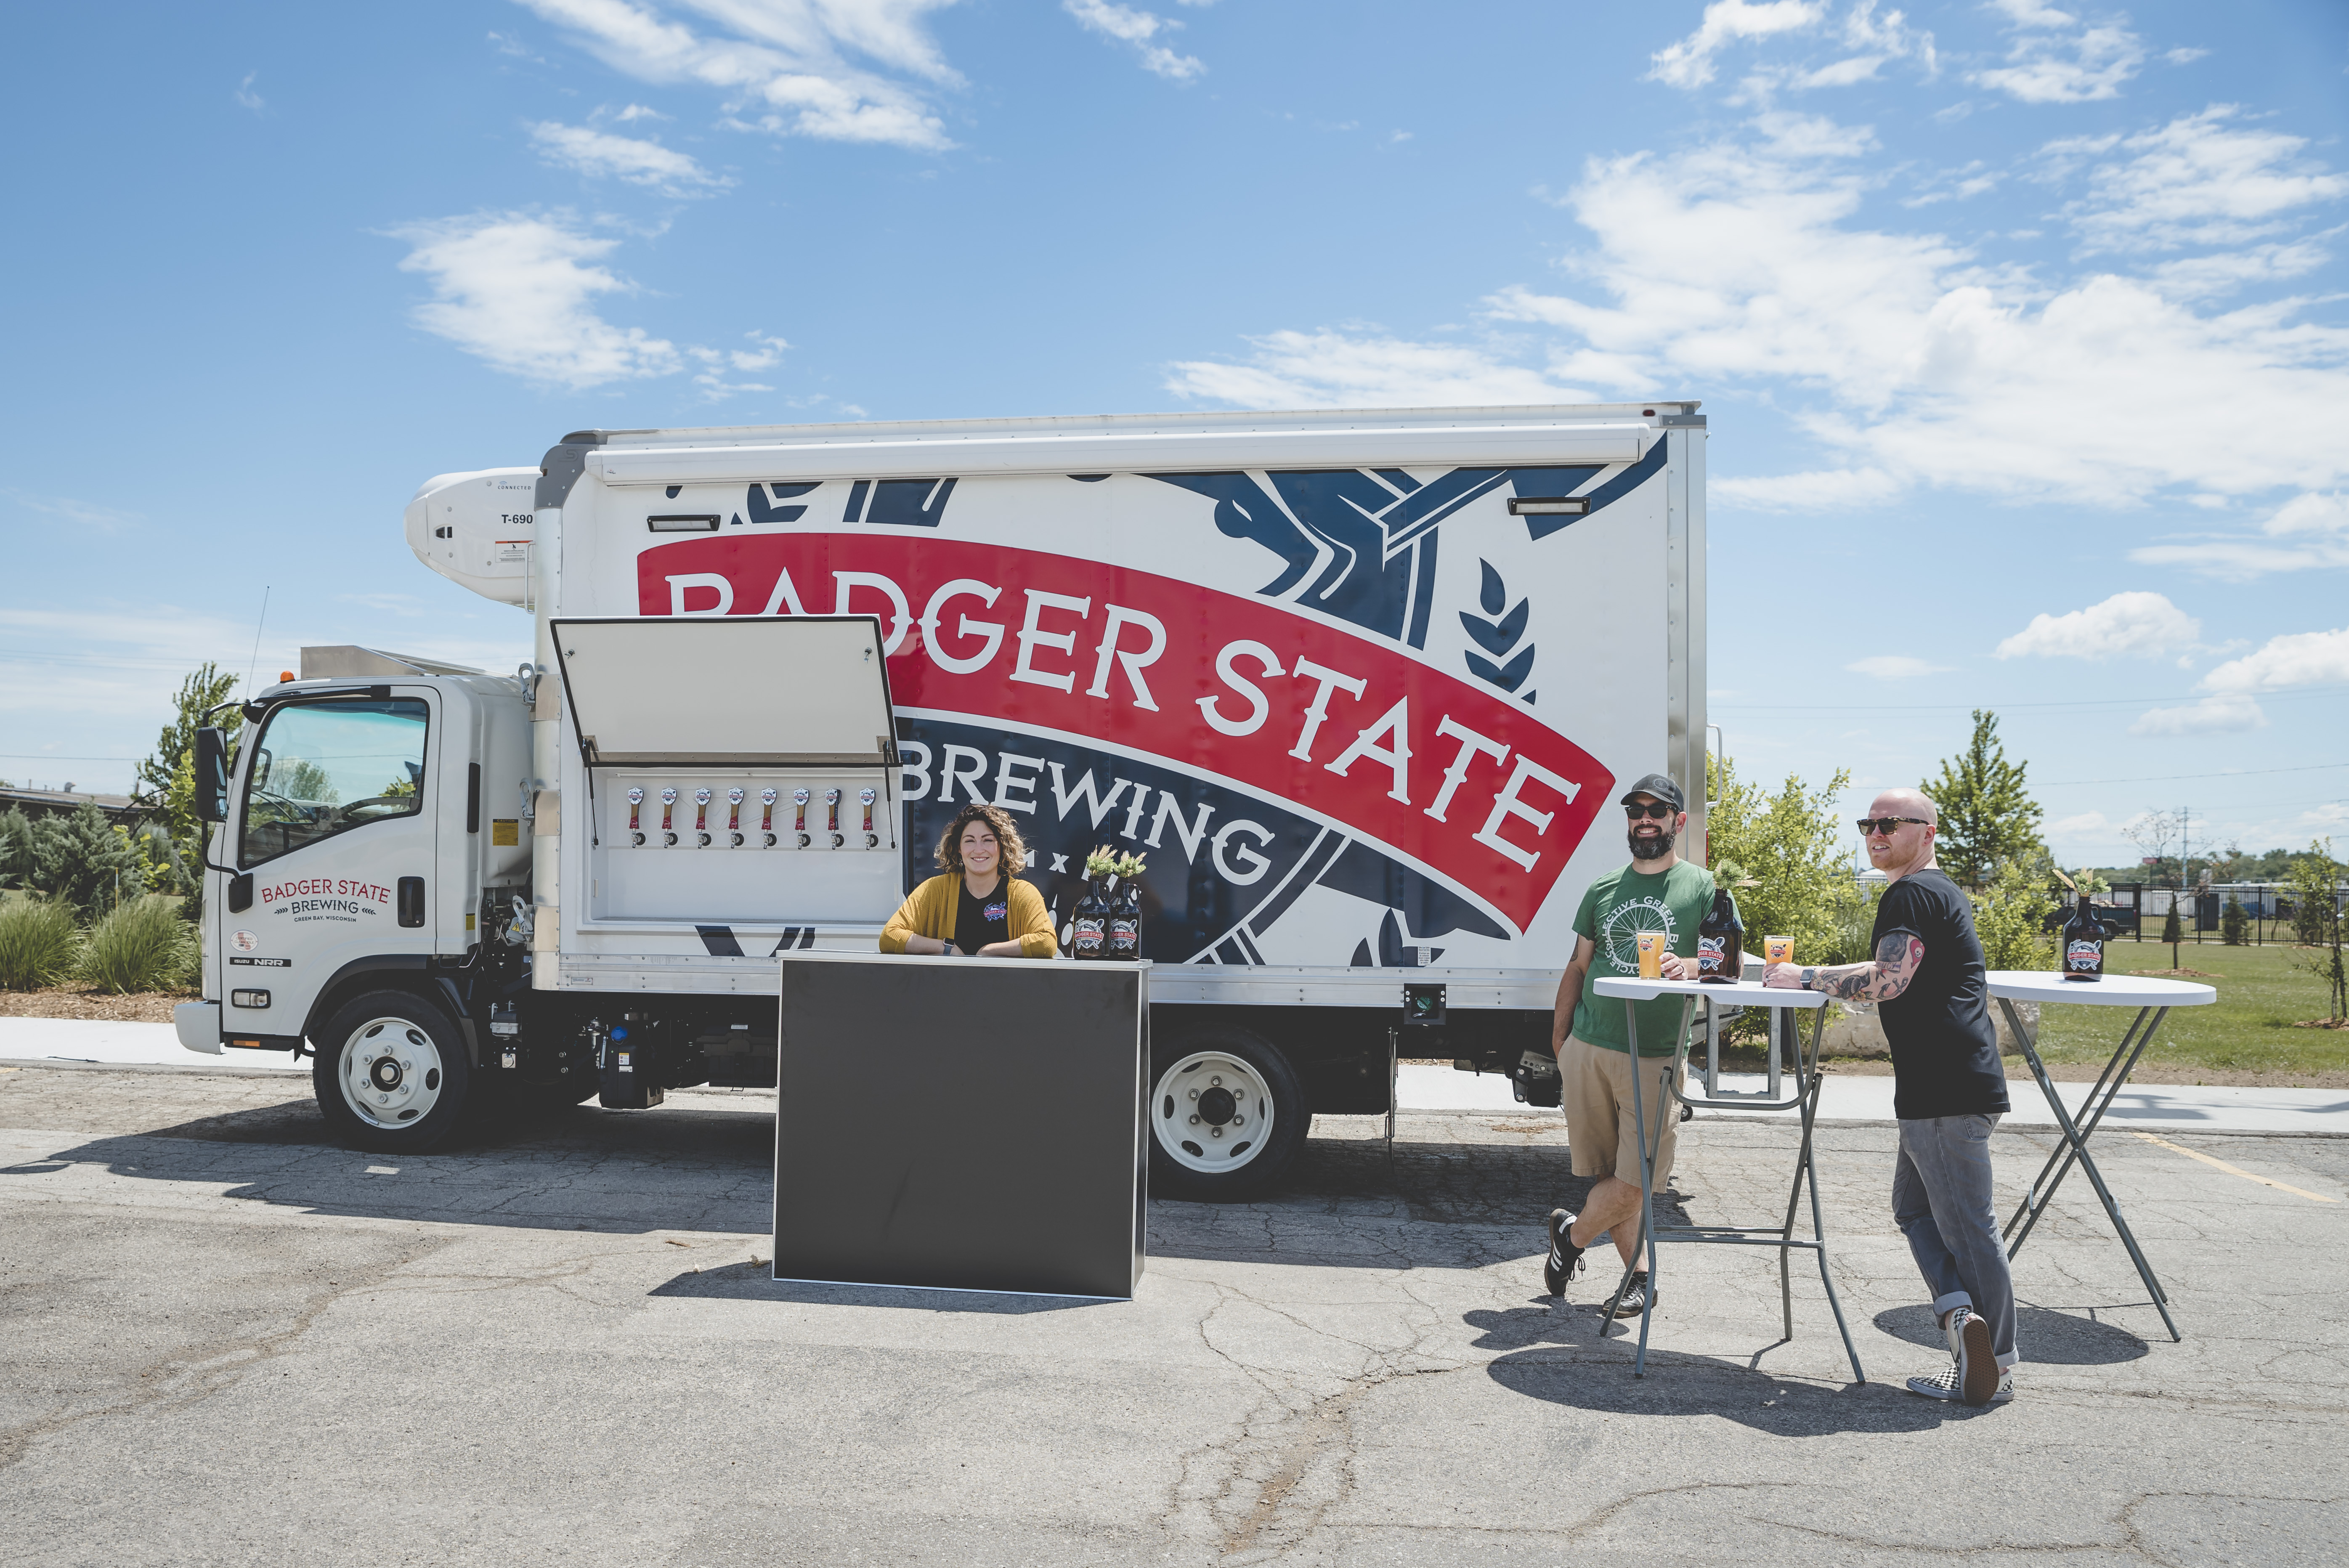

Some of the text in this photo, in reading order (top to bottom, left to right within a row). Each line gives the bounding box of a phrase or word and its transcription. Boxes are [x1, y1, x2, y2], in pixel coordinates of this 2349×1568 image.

[502, 515, 533, 524] T-690
[1195, 639, 1582, 873] STATE
[897, 740, 1275, 886] BREWING
[261, 879, 391, 904] BADGER STATE
[291, 899, 358, 914] BREWING
[1643, 896, 1677, 926] GREEN
[1664, 933, 1679, 951] BA
